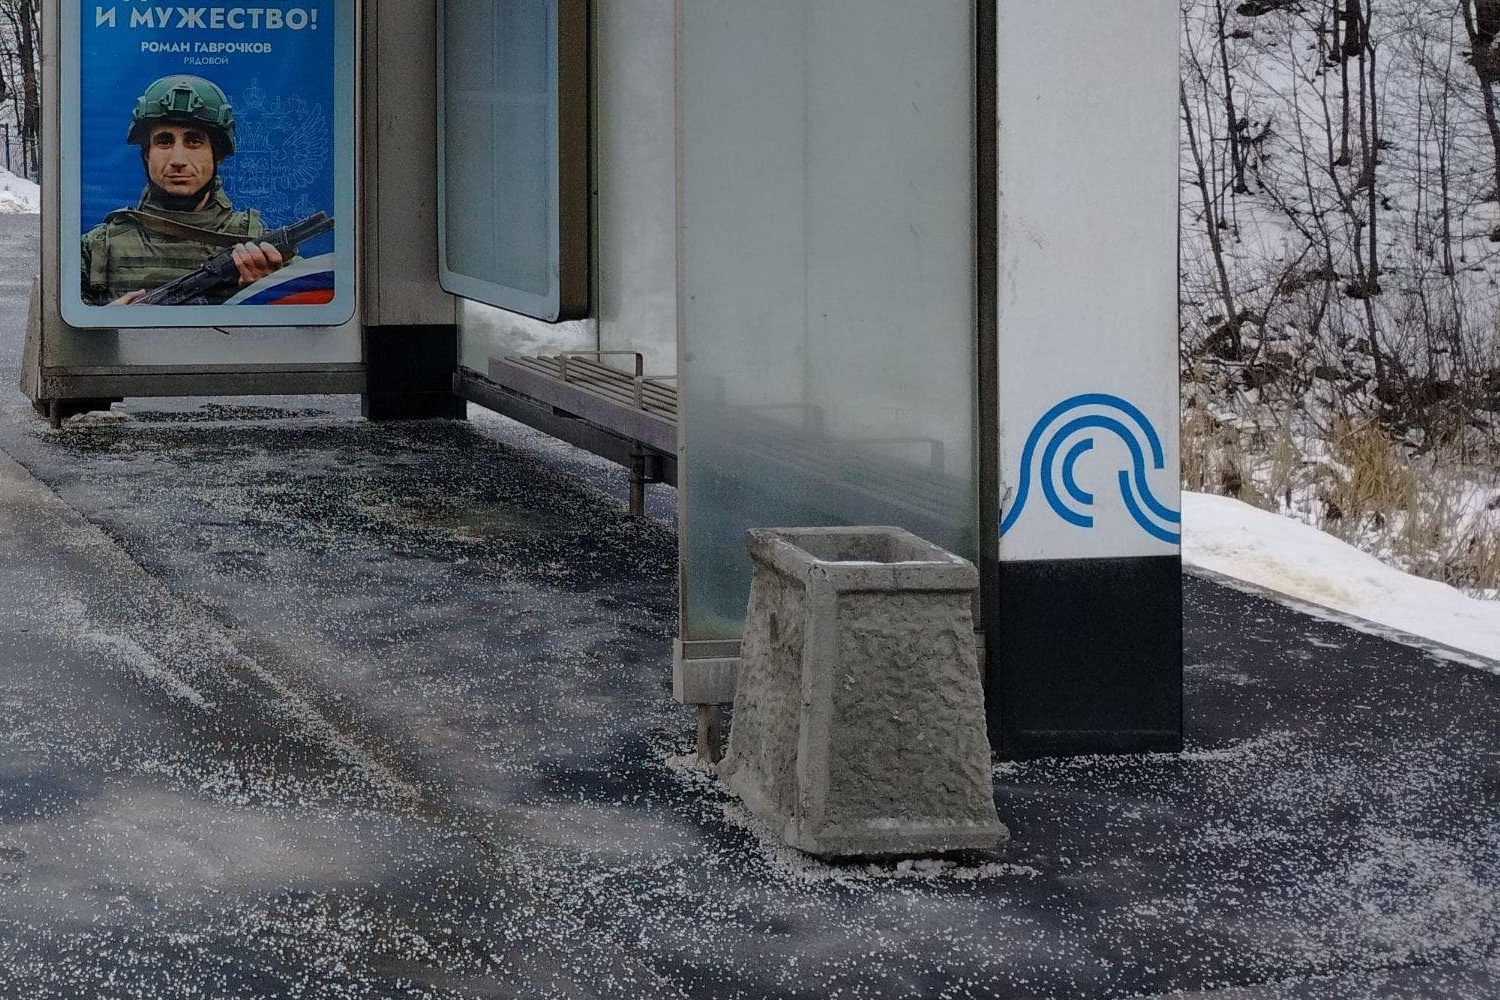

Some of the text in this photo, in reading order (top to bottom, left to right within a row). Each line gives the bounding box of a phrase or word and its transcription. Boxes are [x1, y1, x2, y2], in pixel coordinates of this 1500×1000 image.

[95, 5, 318, 30] И МУЖЕСТВО!
[141, 41, 272, 53] РОМАН ГАВРОЧКОВ
[183, 55, 229, 66] РЯДОВОЙ
